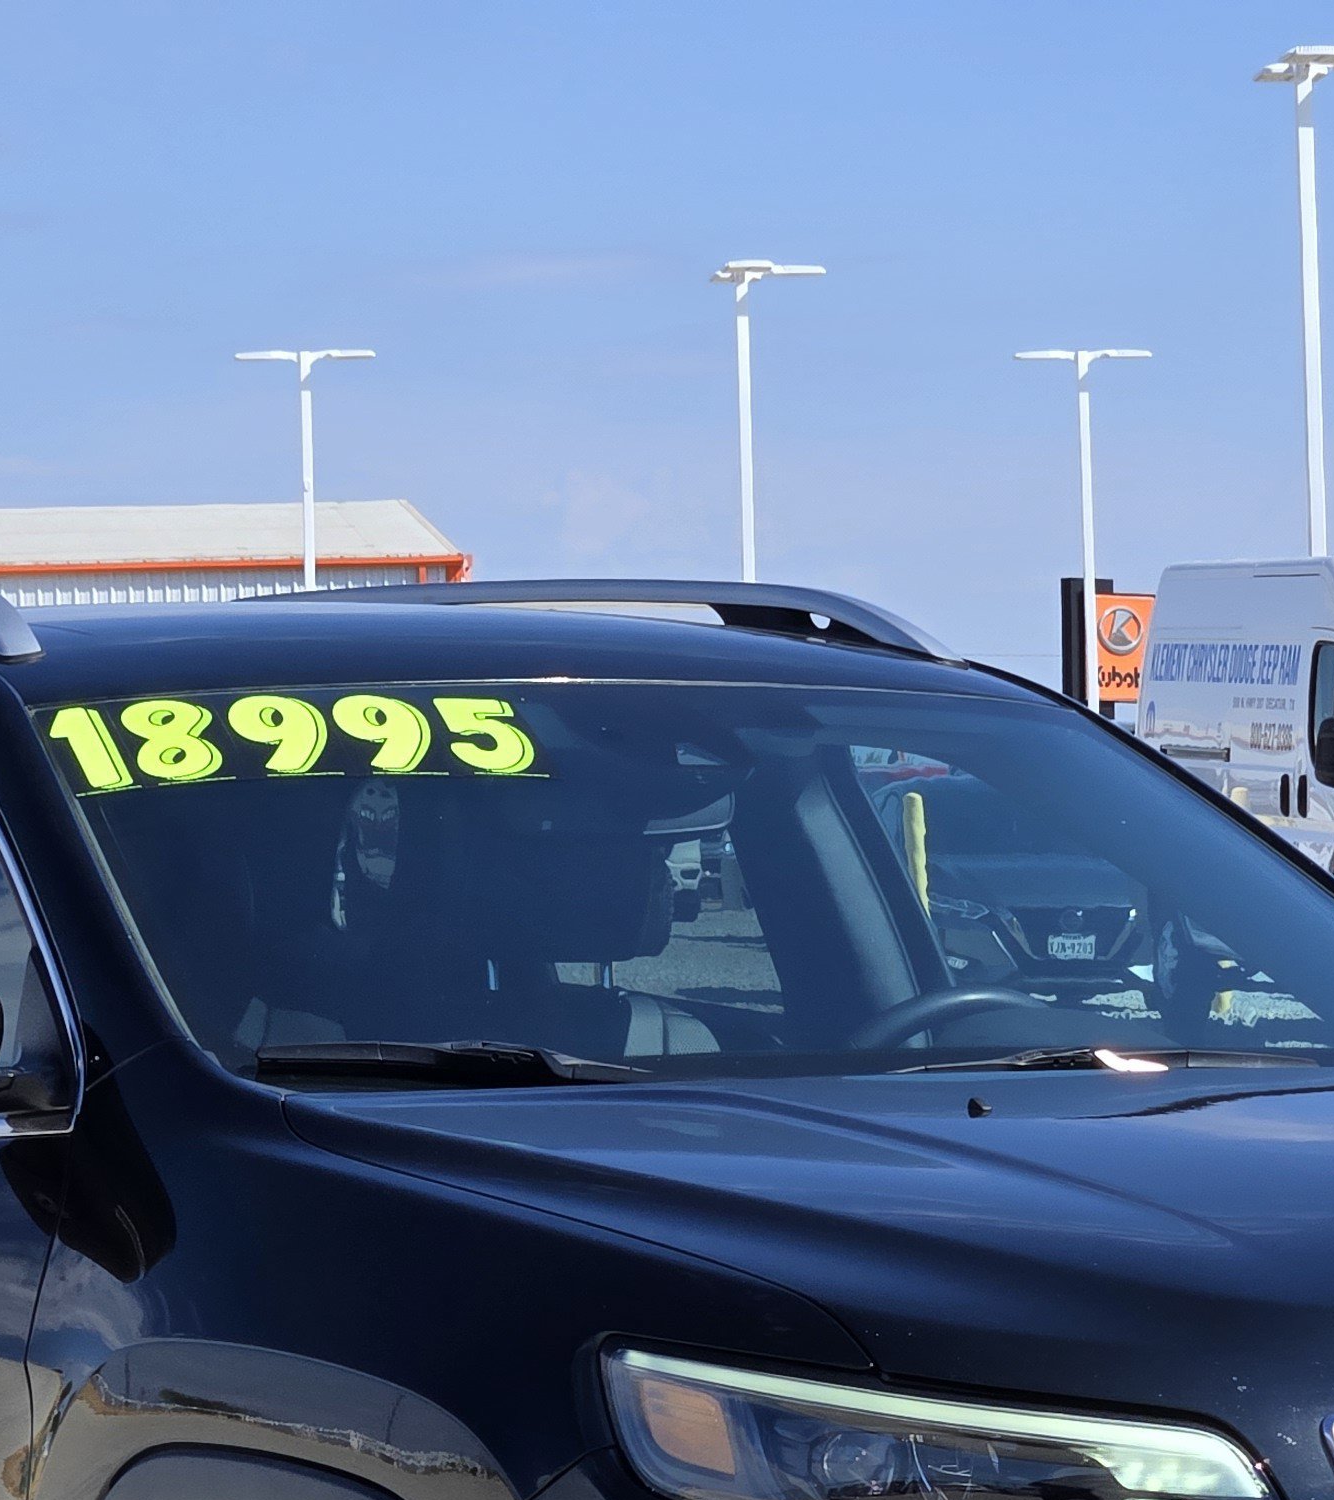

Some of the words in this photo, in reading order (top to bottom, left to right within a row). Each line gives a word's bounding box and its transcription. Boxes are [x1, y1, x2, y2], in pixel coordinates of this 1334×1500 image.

[1098, 665, 1140, 688] Kubot
[1150, 643, 1188, 681] KLEMENT
[1186, 644, 1230, 683] CHRYSLER
[1228, 645, 1259, 684] DODGE
[1257, 645, 1281, 685] JEEP
[1278, 645, 1302, 685] RAM
[49, 694, 535, 789] 18995
